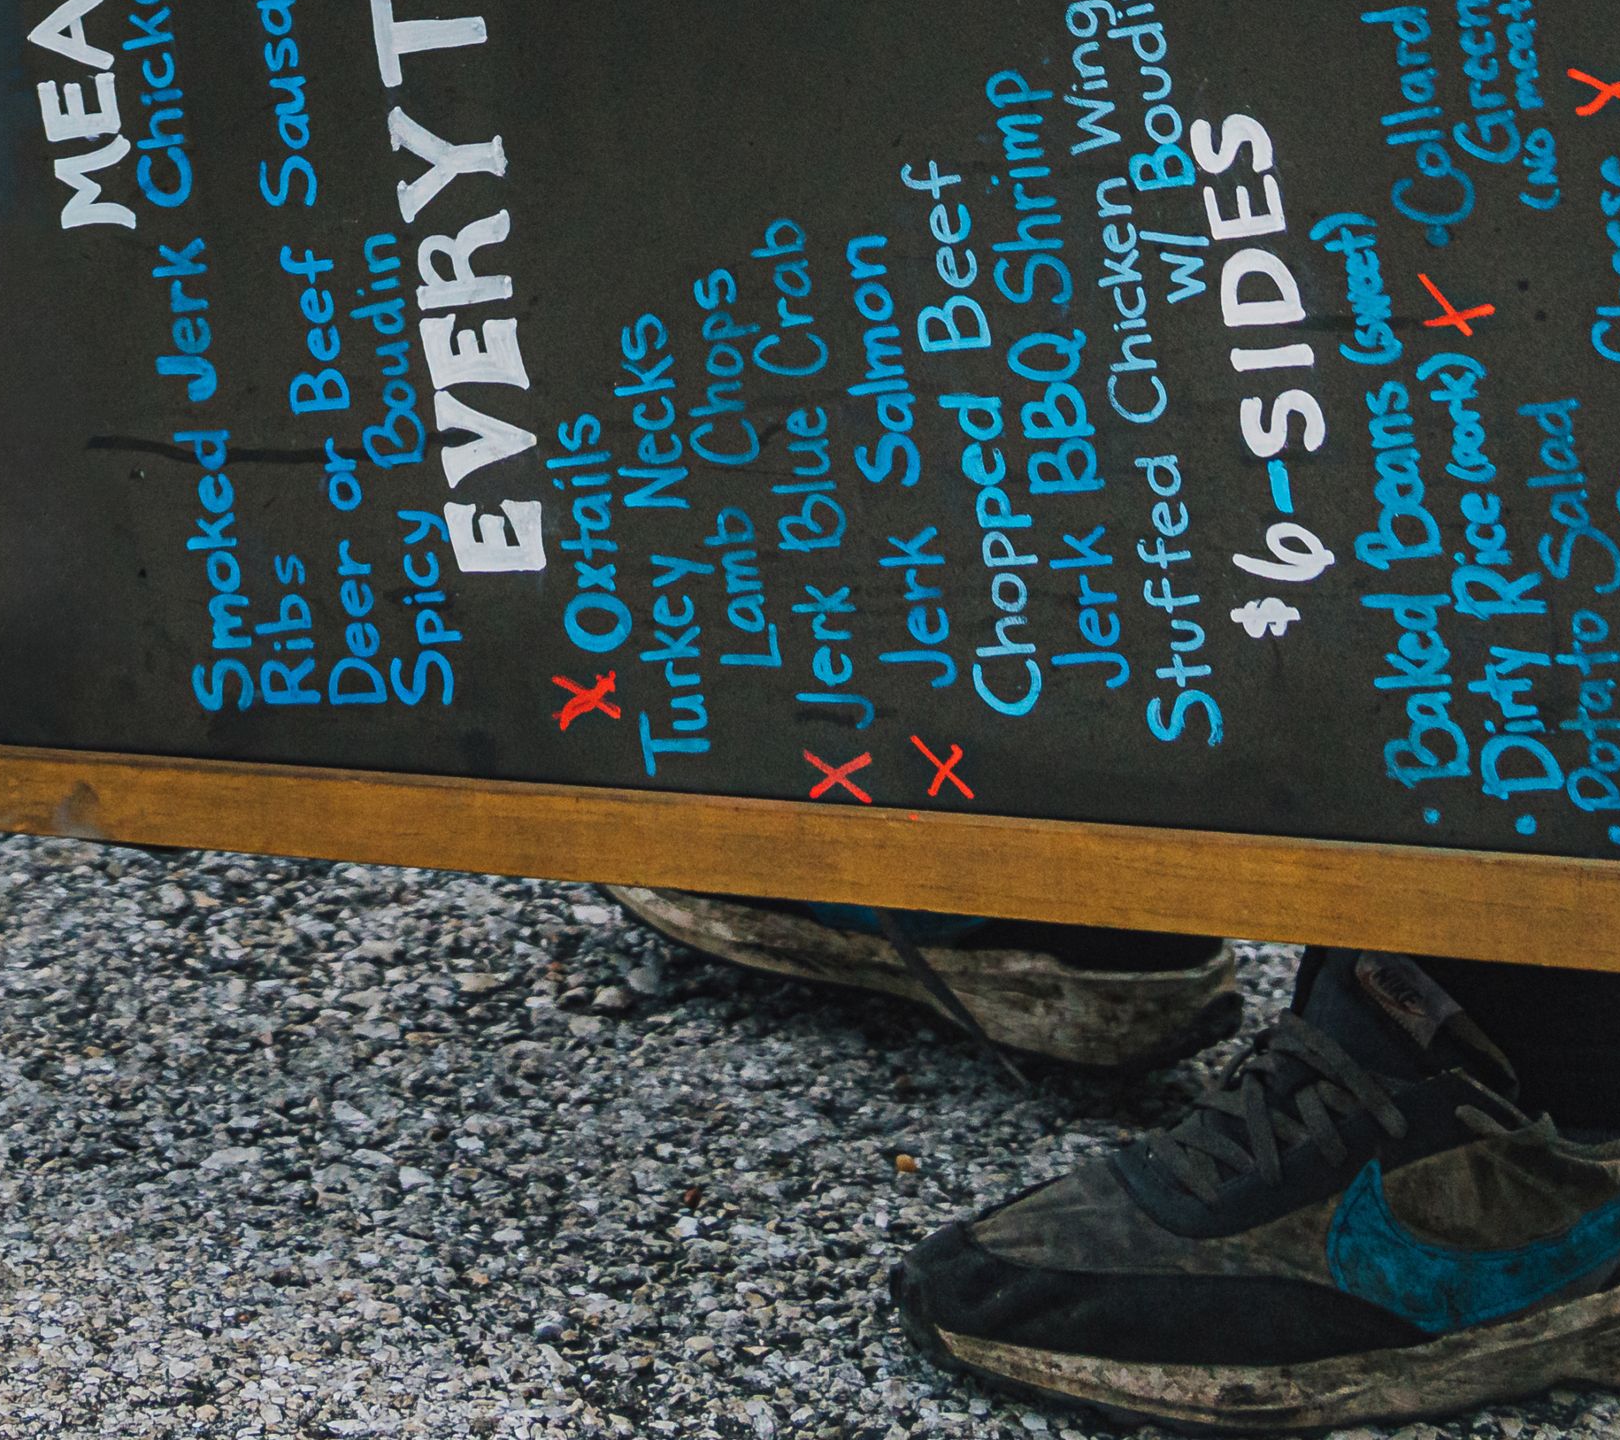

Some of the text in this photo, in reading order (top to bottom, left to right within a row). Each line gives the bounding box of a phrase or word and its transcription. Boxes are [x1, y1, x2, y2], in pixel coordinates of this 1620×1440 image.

[1360, 6, 1476, 226] Collard
[152, 237, 217, 402] Jerk
[280, 245, 350, 416] Beef
[986, 70, 1130, 689] Jerk BBQ Shrimp
[1078, 177, 1167, 424] Chicken
[1141, 231, 1207, 304] w/
[316, 437, 362, 512] or
[350, 233, 463, 706] Spicy Boudin
[546, 413, 632, 653] Oxtails
[614, 313, 715, 776] Turkey Necks
[689, 269, 782, 668] Lamb Chops
[751, 218, 874, 729] Jerk Blue Crab
[846, 235, 958, 688] Jerk Salmon
[900, 160, 1042, 717] Chopped Beef
[1354, 380, 1443, 571] Beans
[173, 429, 257, 711] Smoked
[254, 554, 321, 705] Ribs
[328, 539, 387, 705] Deer
[1135, 455, 1224, 747] Stuffed
[1451, 492, 1547, 621] Rice
[1360, 593, 1472, 788] Baked
[1467, 646, 1565, 800] Dirty
